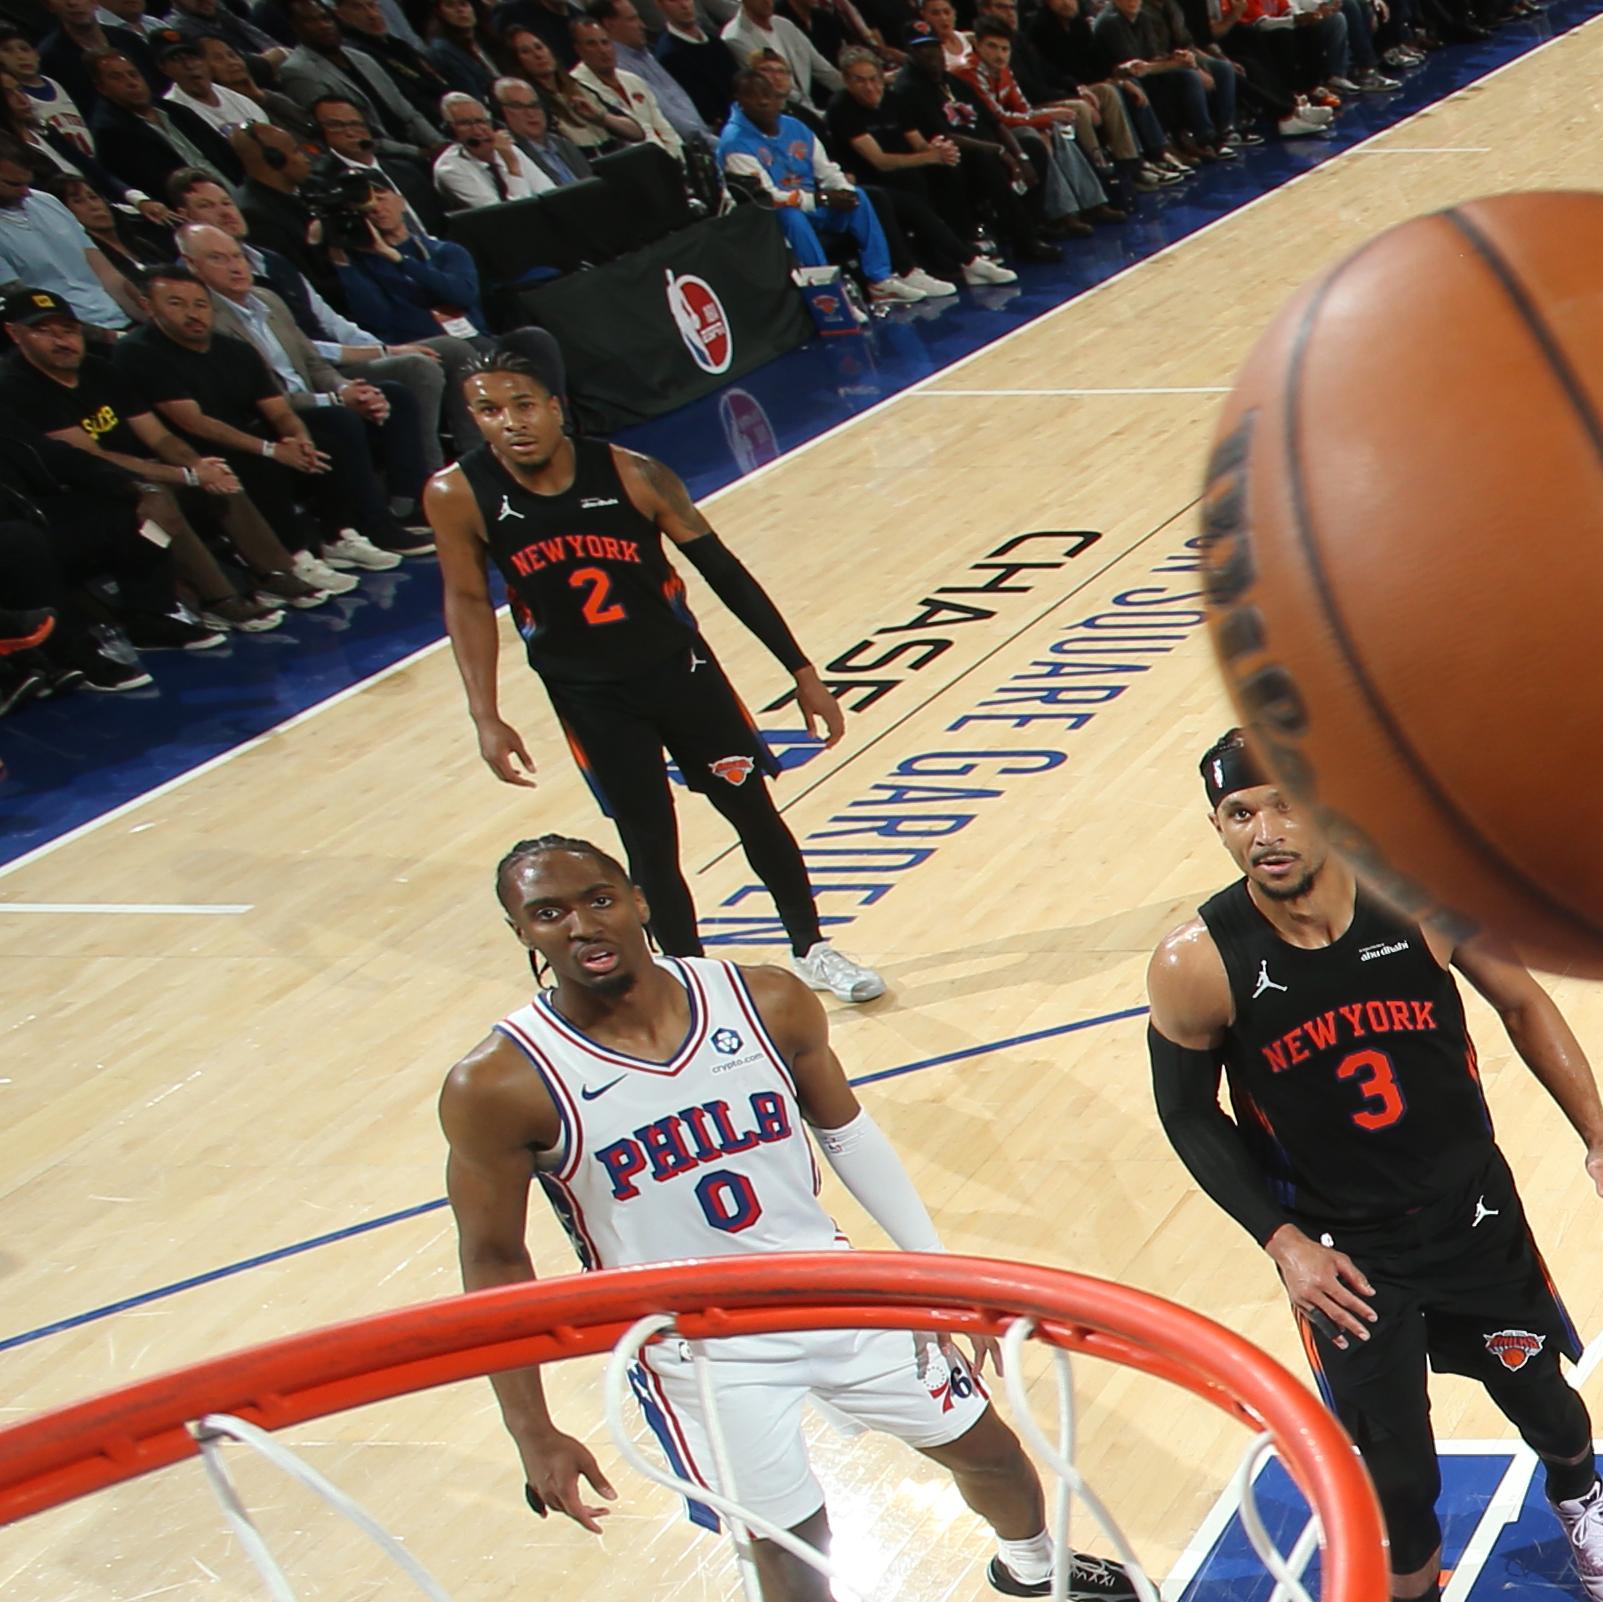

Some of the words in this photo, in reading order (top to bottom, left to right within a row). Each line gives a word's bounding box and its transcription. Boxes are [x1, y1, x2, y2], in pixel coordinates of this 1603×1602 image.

[510, 537, 566, 577] NEW
[565, 534, 641, 564] YORK
[568, 565, 627, 625] 2
[711, 1052, 765, 1075] crypto.com
[1261, 1010, 1337, 1073] NEW
[1339, 1000, 1437, 1037] YORK
[1337, 1048, 1406, 1131] 3
[594, 1091, 792, 1201] PHILA
[694, 1169, 762, 1233] 0
[928, 1366, 973, 1414] 76
